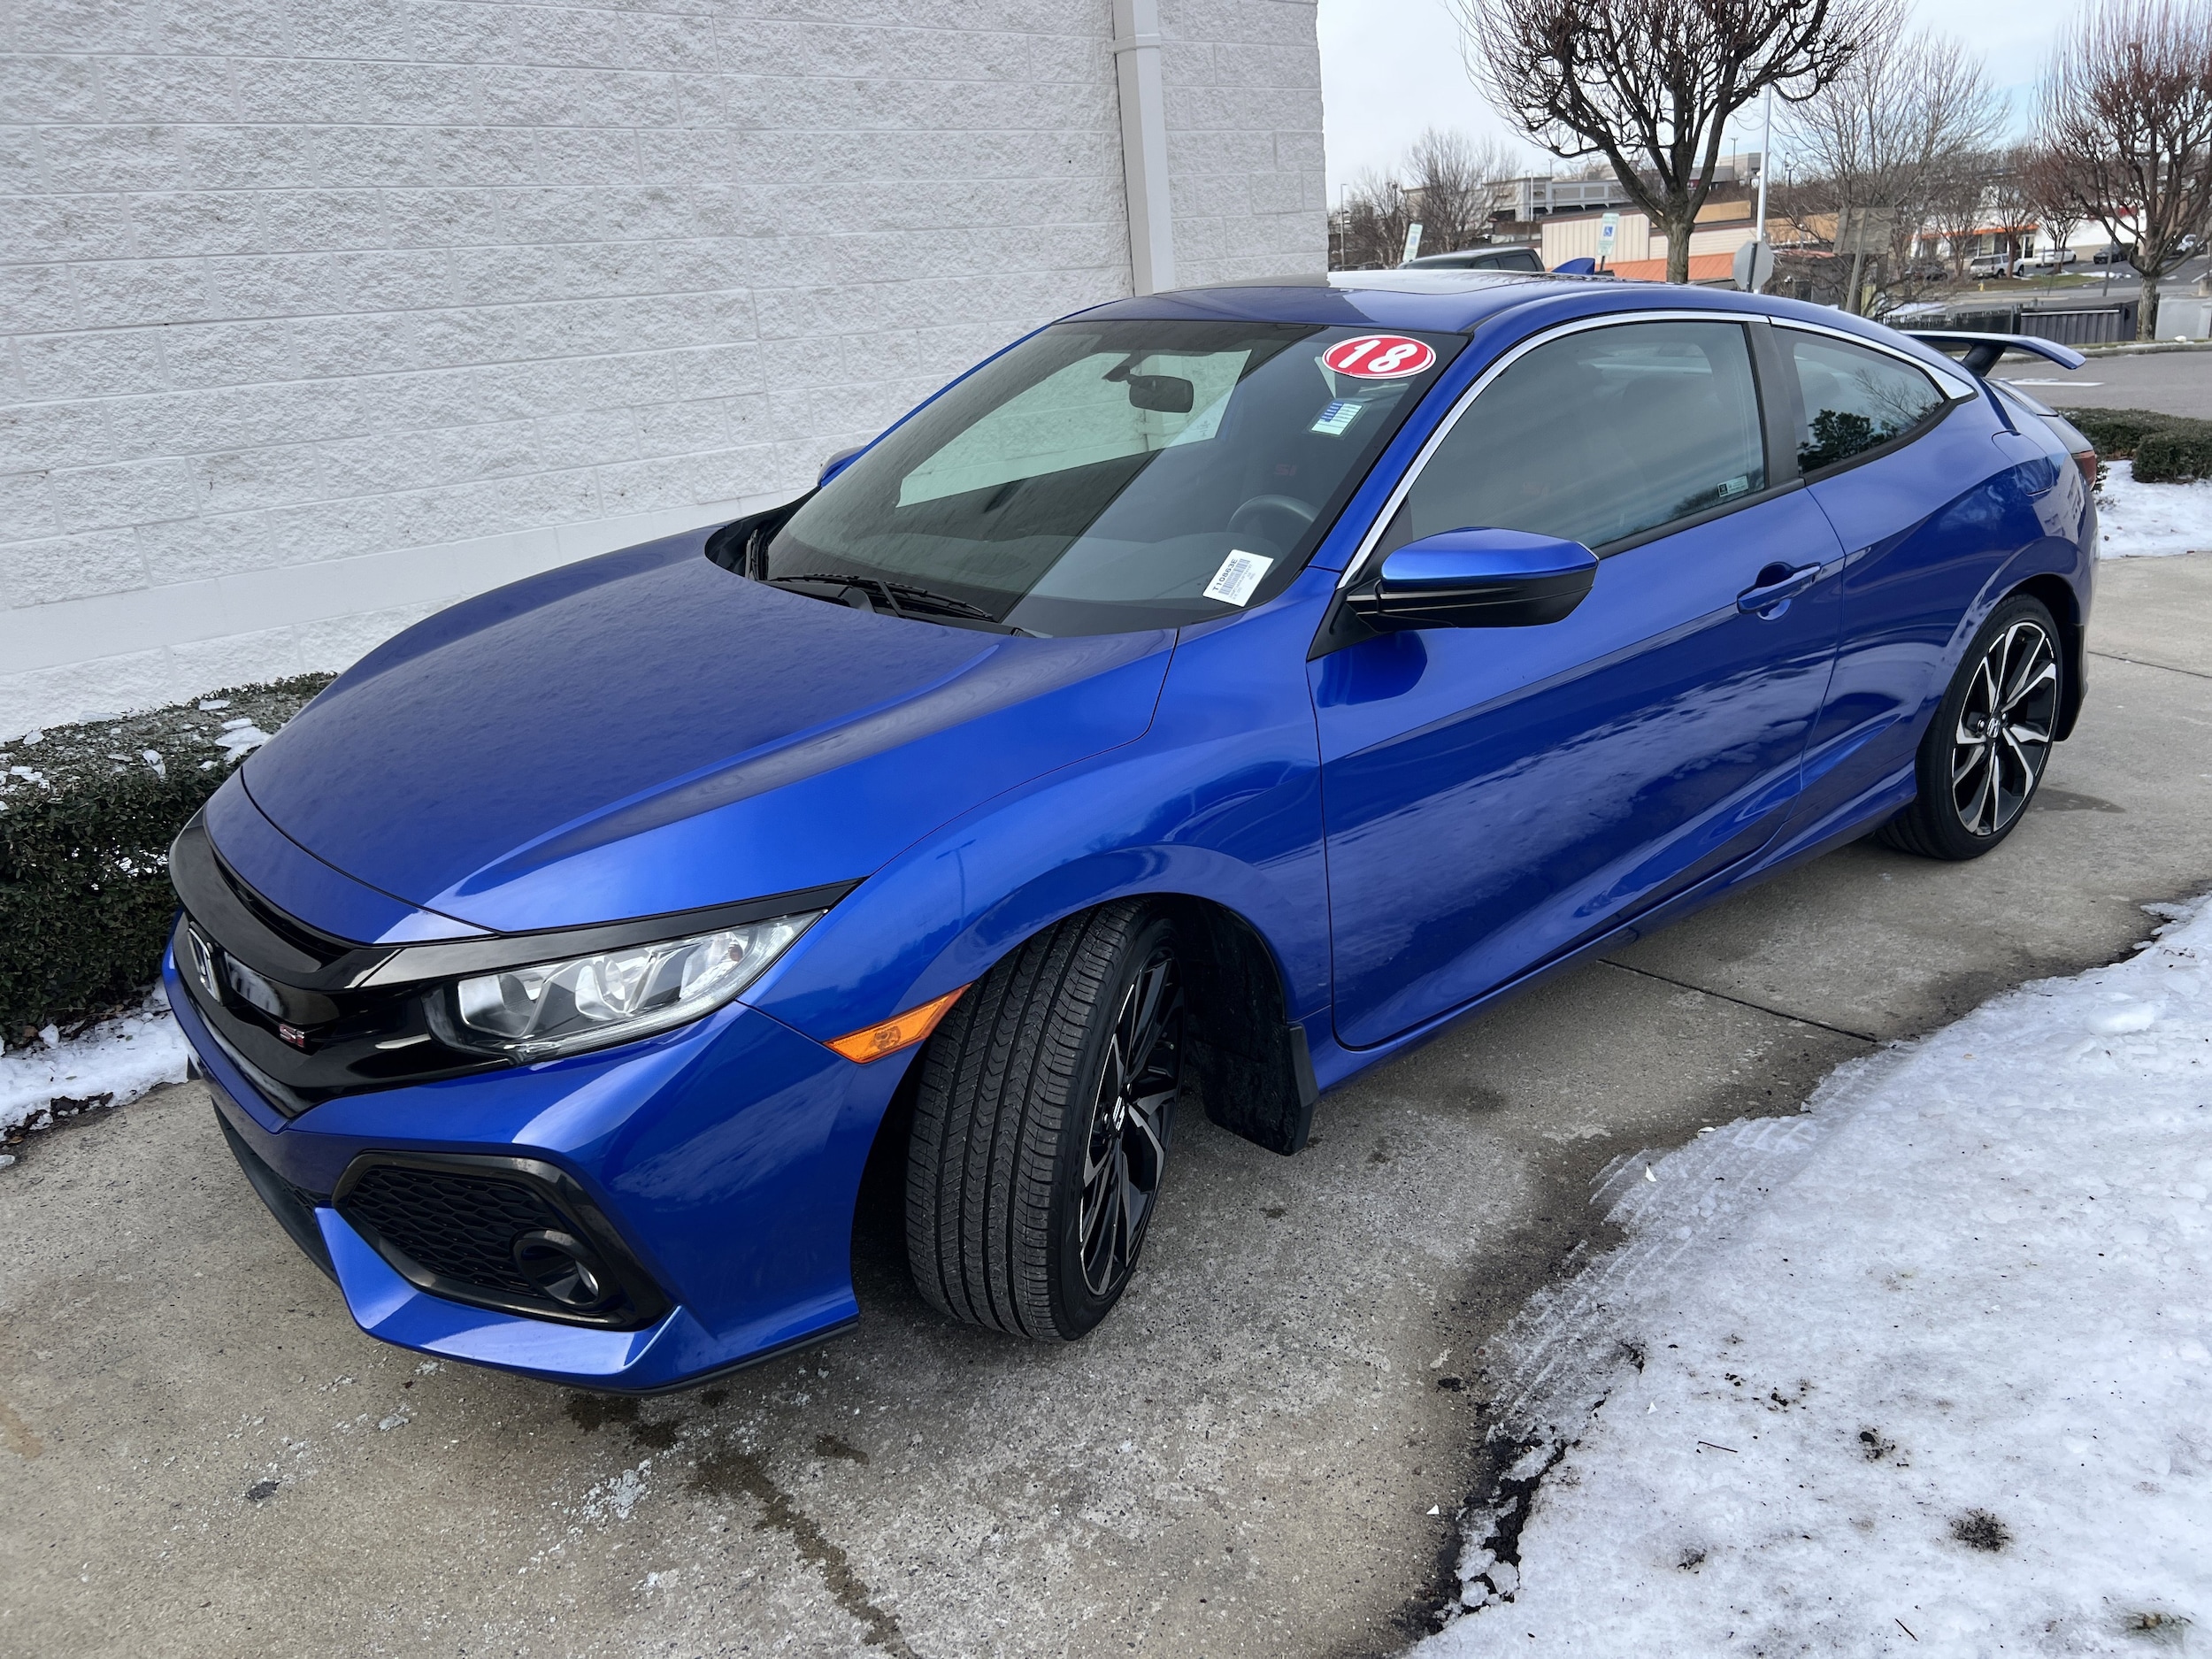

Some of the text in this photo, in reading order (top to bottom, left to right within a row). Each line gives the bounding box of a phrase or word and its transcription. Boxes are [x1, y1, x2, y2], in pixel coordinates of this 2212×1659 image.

[1337, 339, 1418, 373] 18
[1211, 558, 1239, 591] T10863E
[280, 1023, 305, 1048] Si
